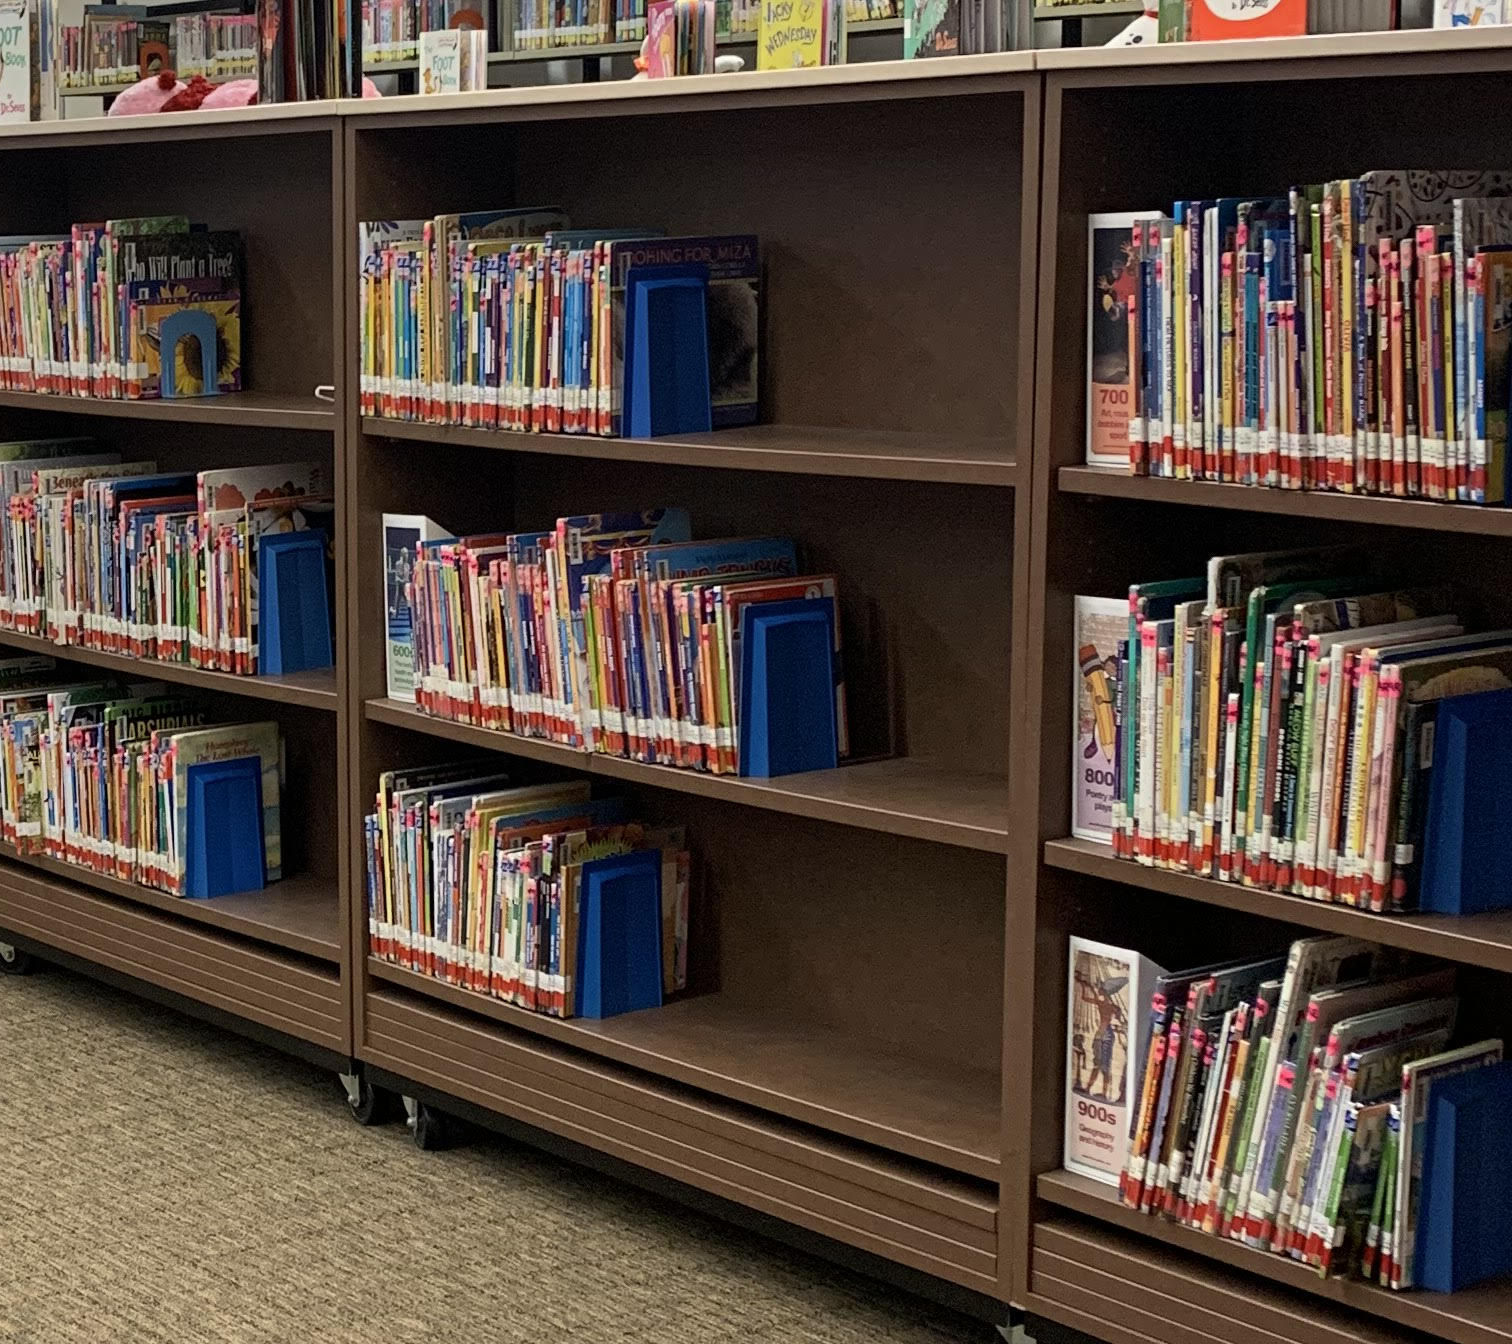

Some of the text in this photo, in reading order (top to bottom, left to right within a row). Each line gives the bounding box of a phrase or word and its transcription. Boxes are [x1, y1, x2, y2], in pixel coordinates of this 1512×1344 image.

[765, 27, 818, 57] WEDNESDAY
[148, 256, 168, 280] Will
[171, 255, 196, 280] Plant
[198, 258, 205, 277] a
[209, 253, 233, 278] Tree?
[1343, 320, 1352, 352] OLIVIA
[1099, 389, 1128, 405] 700
[125, 713, 205, 741] ARSUPIALS
[1274, 728, 1285, 803] DOG-GONE SCHOOL
[1078, 1100, 1117, 1126] 900s
